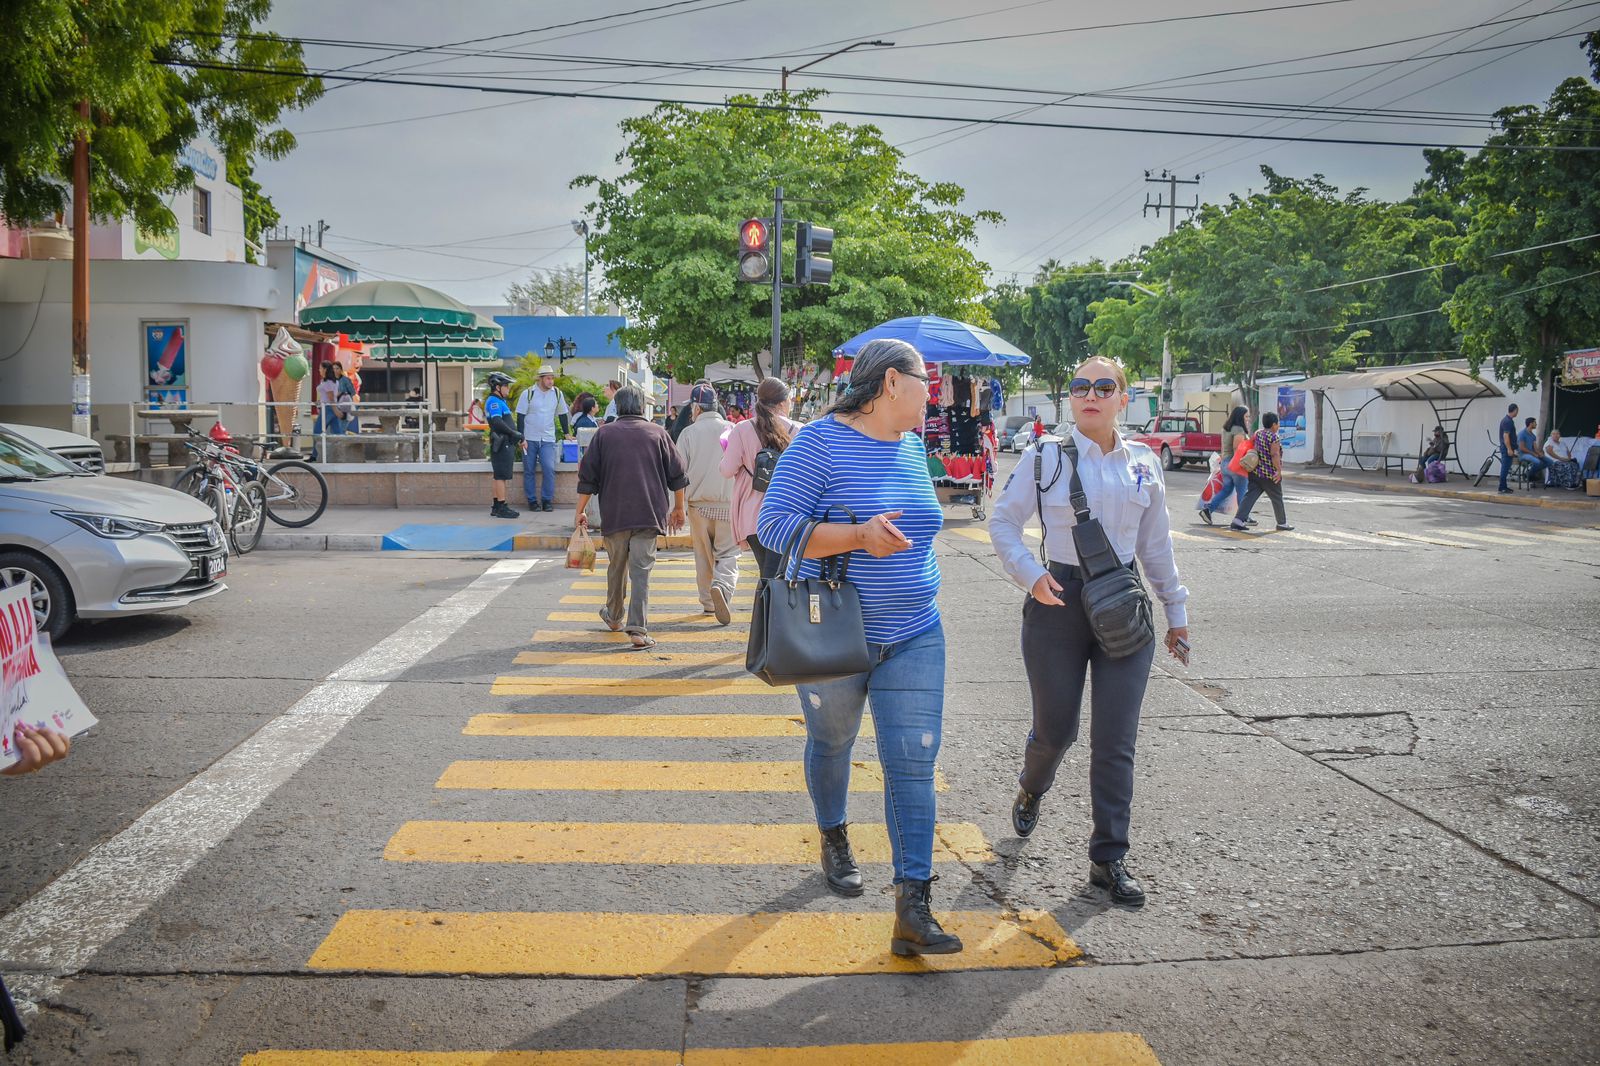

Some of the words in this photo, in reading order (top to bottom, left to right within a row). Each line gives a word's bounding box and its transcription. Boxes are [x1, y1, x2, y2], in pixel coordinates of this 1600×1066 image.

[209, 557, 225, 574] 2024
[7, 603, 22, 650] A
[16, 596, 33, 647] LA
